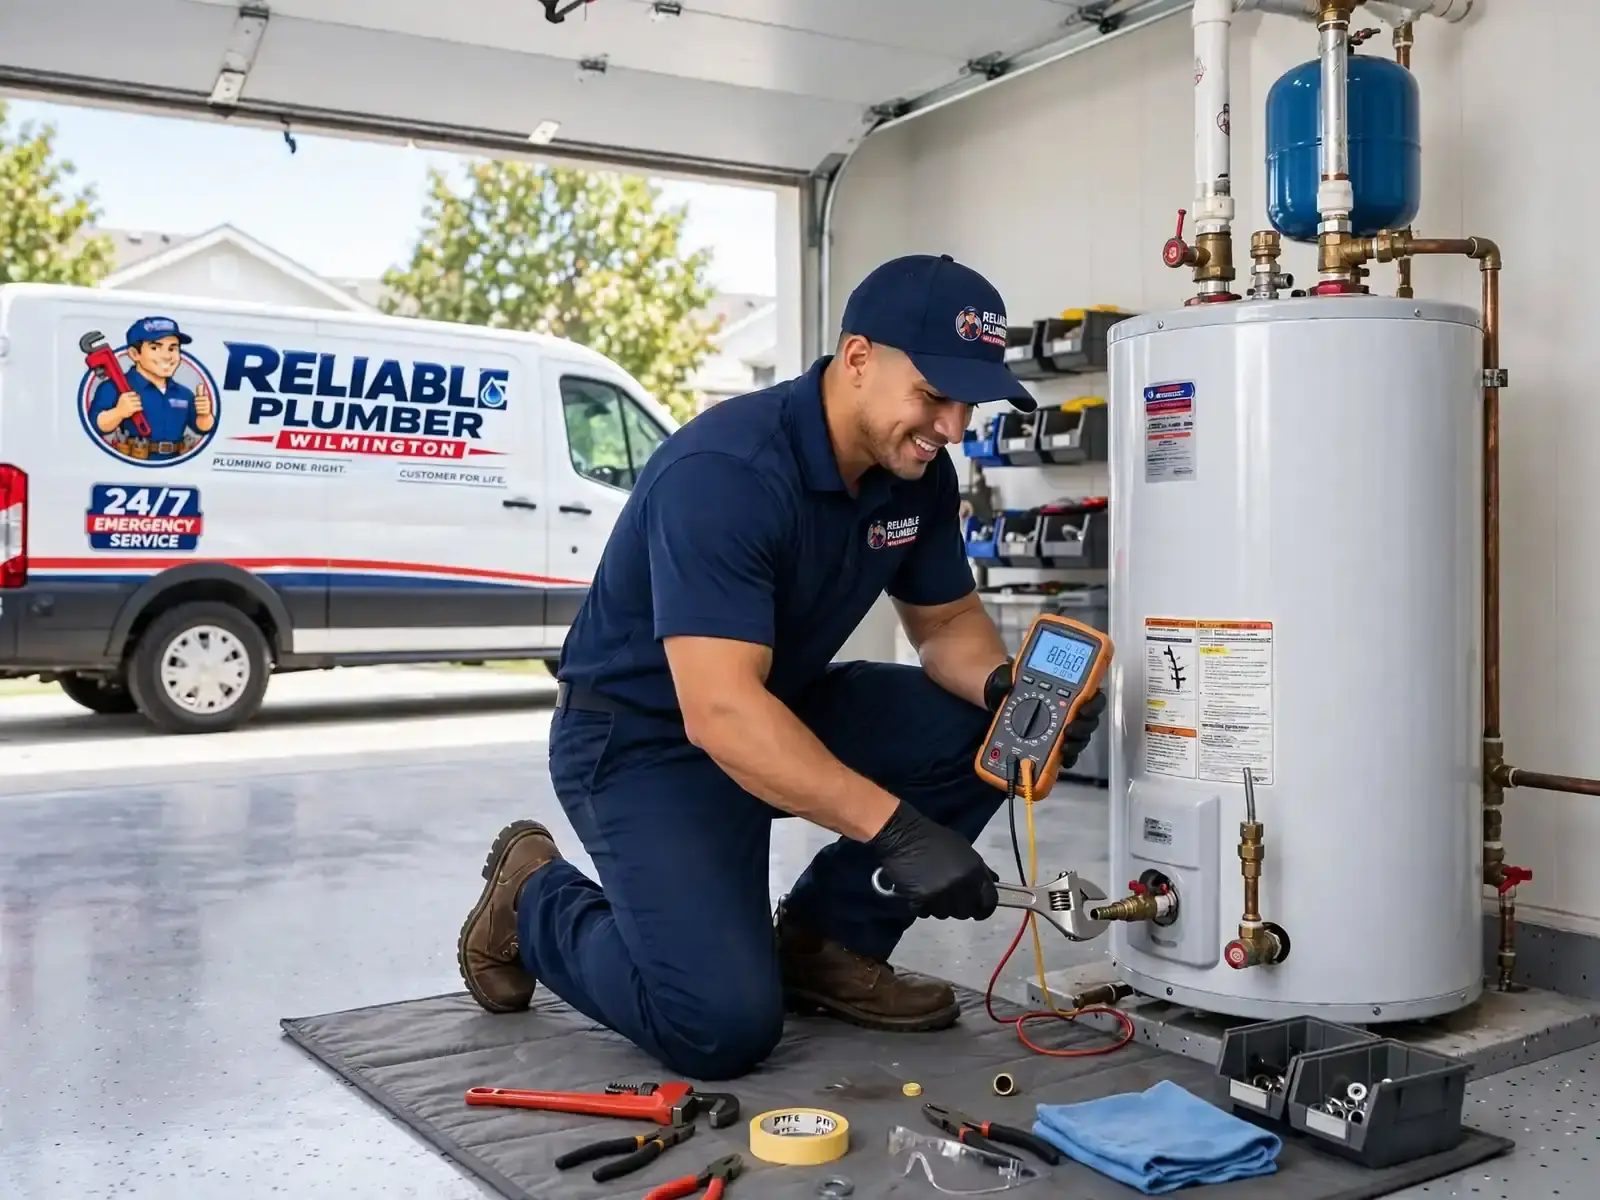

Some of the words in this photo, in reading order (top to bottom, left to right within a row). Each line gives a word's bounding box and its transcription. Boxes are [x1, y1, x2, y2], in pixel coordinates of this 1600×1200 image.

[223, 341, 509, 410] RELIABLE
[249, 397, 483, 439] PLUMBER
[289, 433, 456, 456] WILMINGTON
[212, 458, 272, 469] PLUMBING
[275, 462, 307, 471] DONE
[310, 464, 347, 473] RIGHT.
[399, 470, 457, 480] CUSTOMER
[459, 473, 480, 482] FOR
[103, 487, 191, 517] 24/7
[93, 517, 195, 533] EMERGENCY
[886, 515, 920, 531] RELIABLE
[109, 533, 180, 548] SERVICE
[773, 1115, 801, 1126] PTFE
